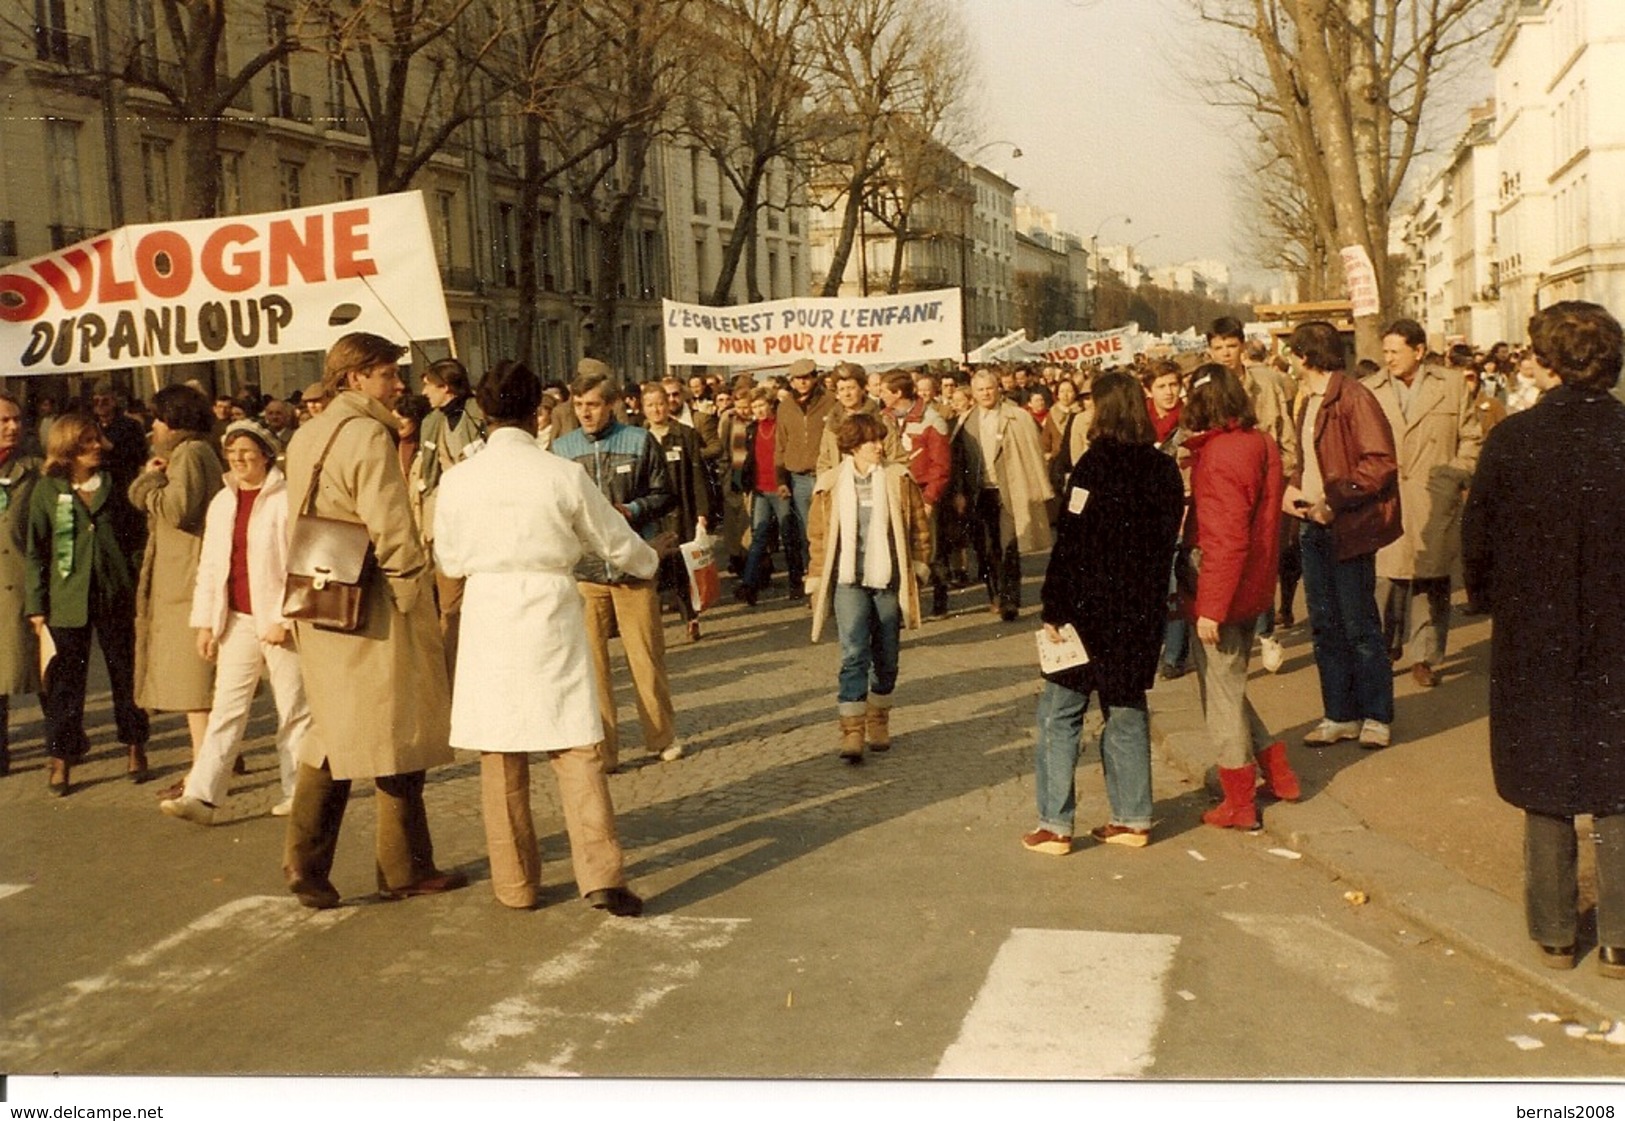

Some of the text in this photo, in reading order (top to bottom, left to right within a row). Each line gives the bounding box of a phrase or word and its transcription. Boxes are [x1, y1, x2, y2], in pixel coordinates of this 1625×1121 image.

[21, 293, 293, 367] DUPANLOUP
[738, 312, 773, 333] EST
[782, 308, 833, 330] POUR
[840, 300, 945, 328] L'ENFANT,
[718, 337, 756, 354] NON
[763, 333, 815, 354] POUR
